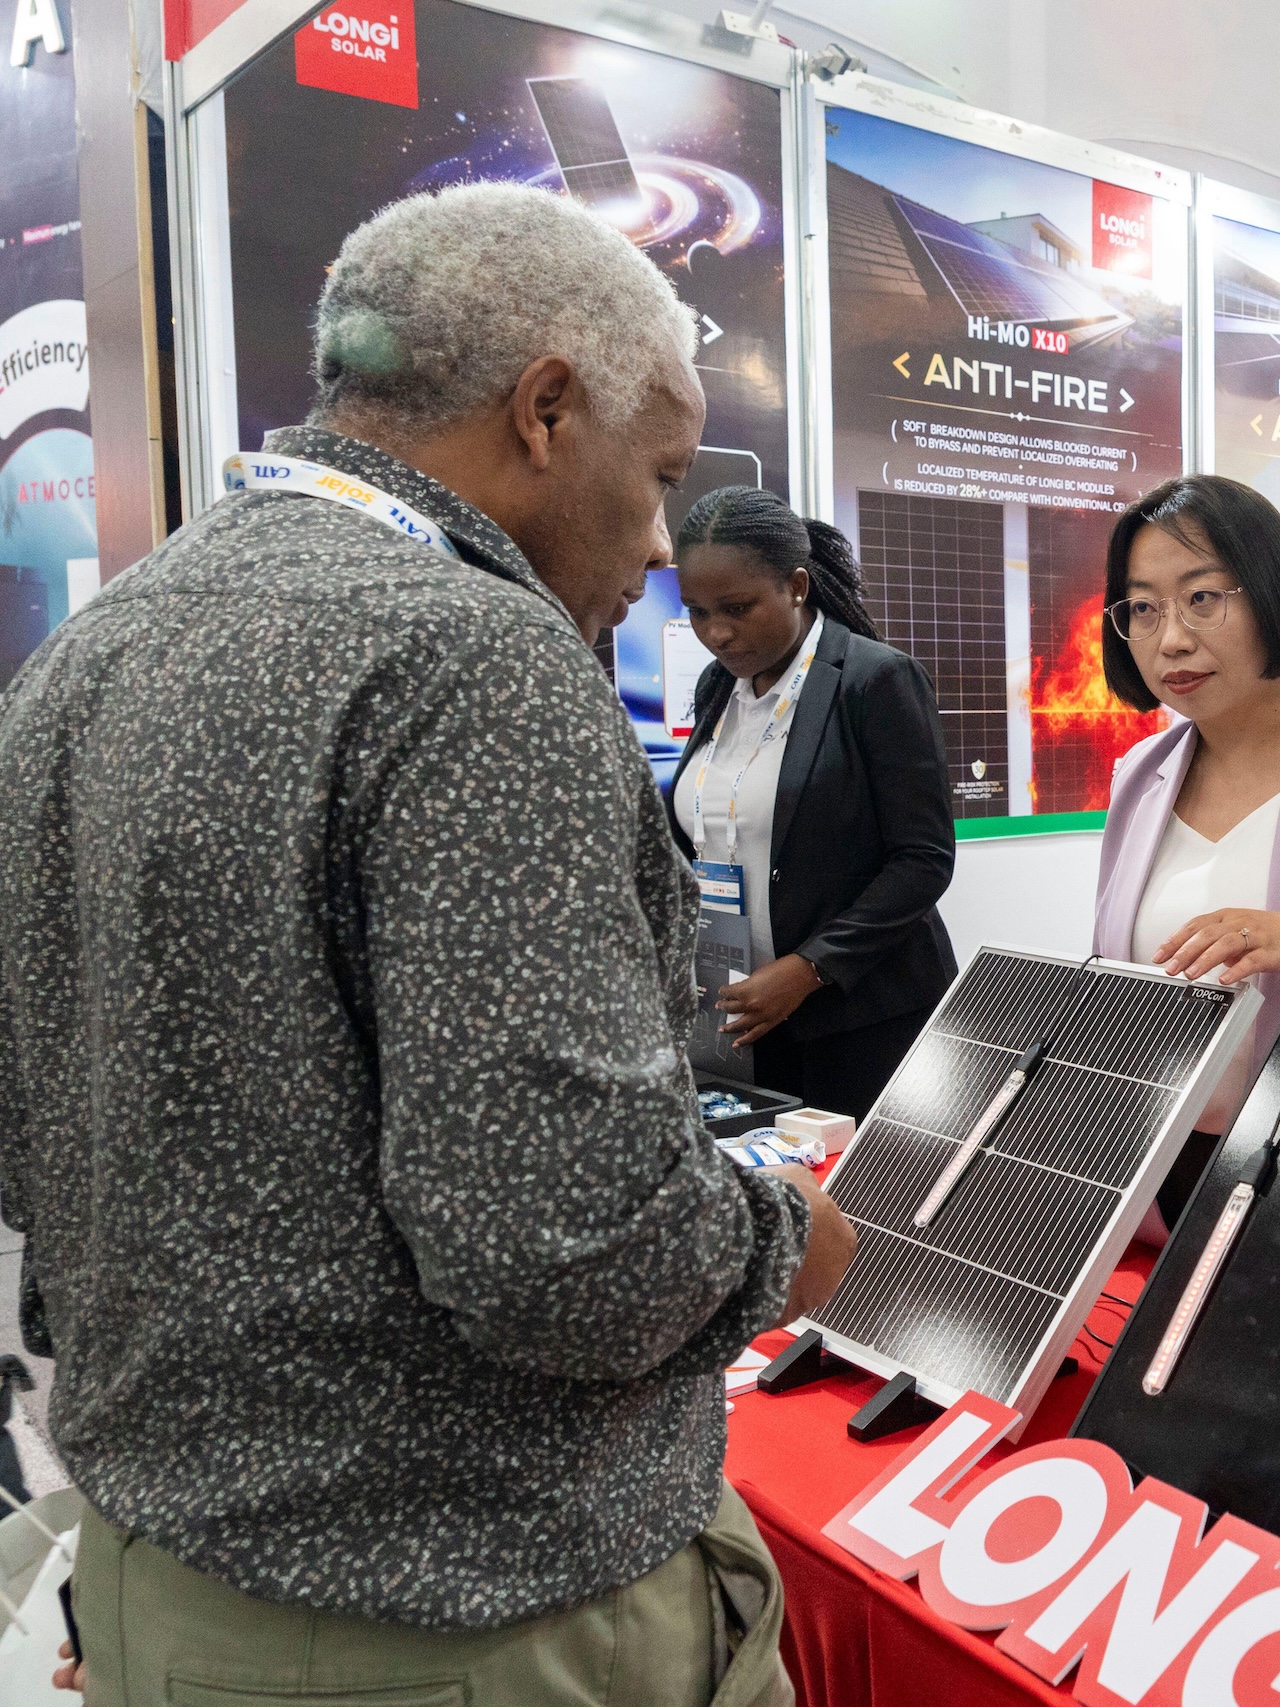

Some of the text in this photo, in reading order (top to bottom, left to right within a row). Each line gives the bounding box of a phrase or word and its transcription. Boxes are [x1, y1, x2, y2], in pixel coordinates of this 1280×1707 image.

[331, 37, 386, 63] SOLAR
[1109, 233, 1137, 248] SOLAR
[967, 315, 1067, 353] Hi-MO X10
[923, 353, 1108, 413] ANTI-FIRE
[903, 420, 1127, 459] SOFT BREAKDOWN DESIGN ALLOWS BLOCKED CURRENT
[914, 436, 1118, 472] TO BYPASS AND PREVENT LOCALIZED OVERHEATING
[250, 465, 291, 479] CATL
[917, 463, 1115, 495] LOCALIZED TEMEPRATURE OF LONGI BC MODULES
[315, 474, 378, 503] solar
[894, 479, 903, 490] IS
[904, 480, 945, 495] REDUCED
[946, 484, 958, 496] BY
[959, 483, 987, 498] 28%+
[988, 489, 1028, 503] COMPARE
[1030, 494, 1051, 505] WITH
[1052, 496, 1112, 512] CONVENTIONAL
[387, 505, 431, 544] CATL
[1192, 988, 1224, 1001] TOPCon
